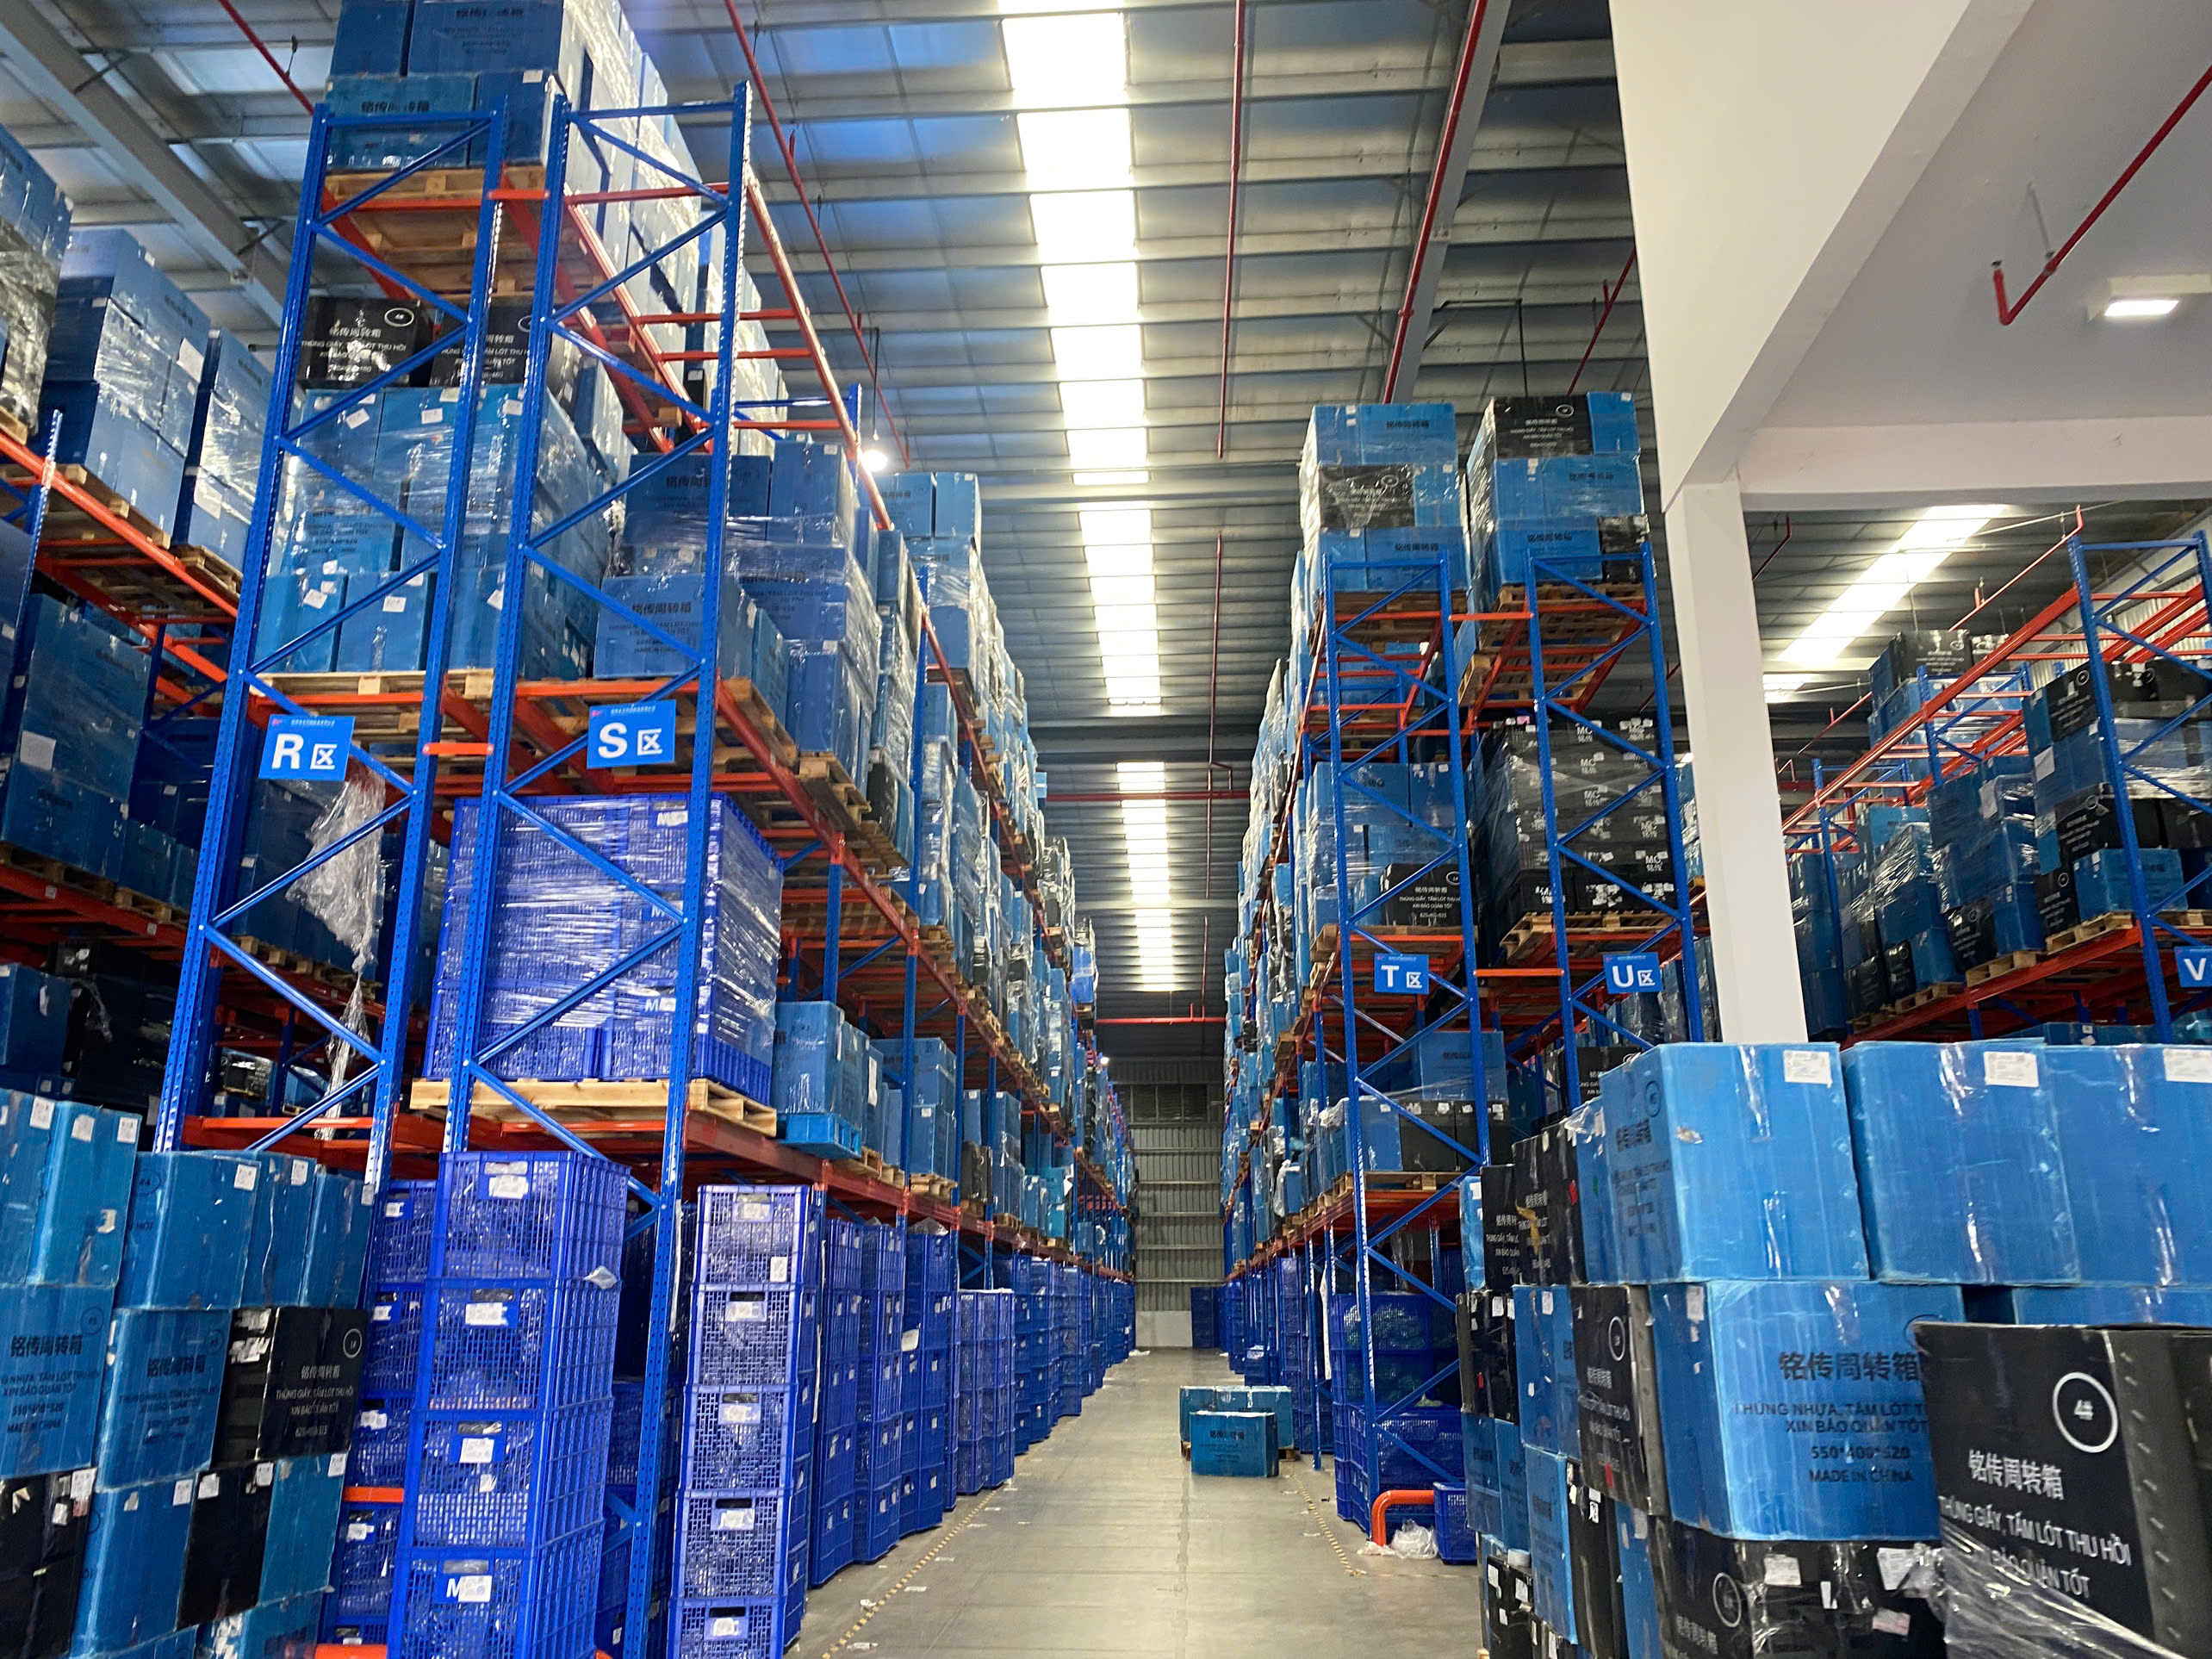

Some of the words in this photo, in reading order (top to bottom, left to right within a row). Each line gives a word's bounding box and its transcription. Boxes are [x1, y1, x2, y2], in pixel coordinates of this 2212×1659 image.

[1779, 1351, 1921, 1382] 铭传周转箱
[1809, 1469, 1849, 1482] MADE
[1868, 1468, 1914, 1482] CHINA
[1968, 1448, 2065, 1501] 铭传周转箱
[2066, 1530, 2098, 1557] THU
